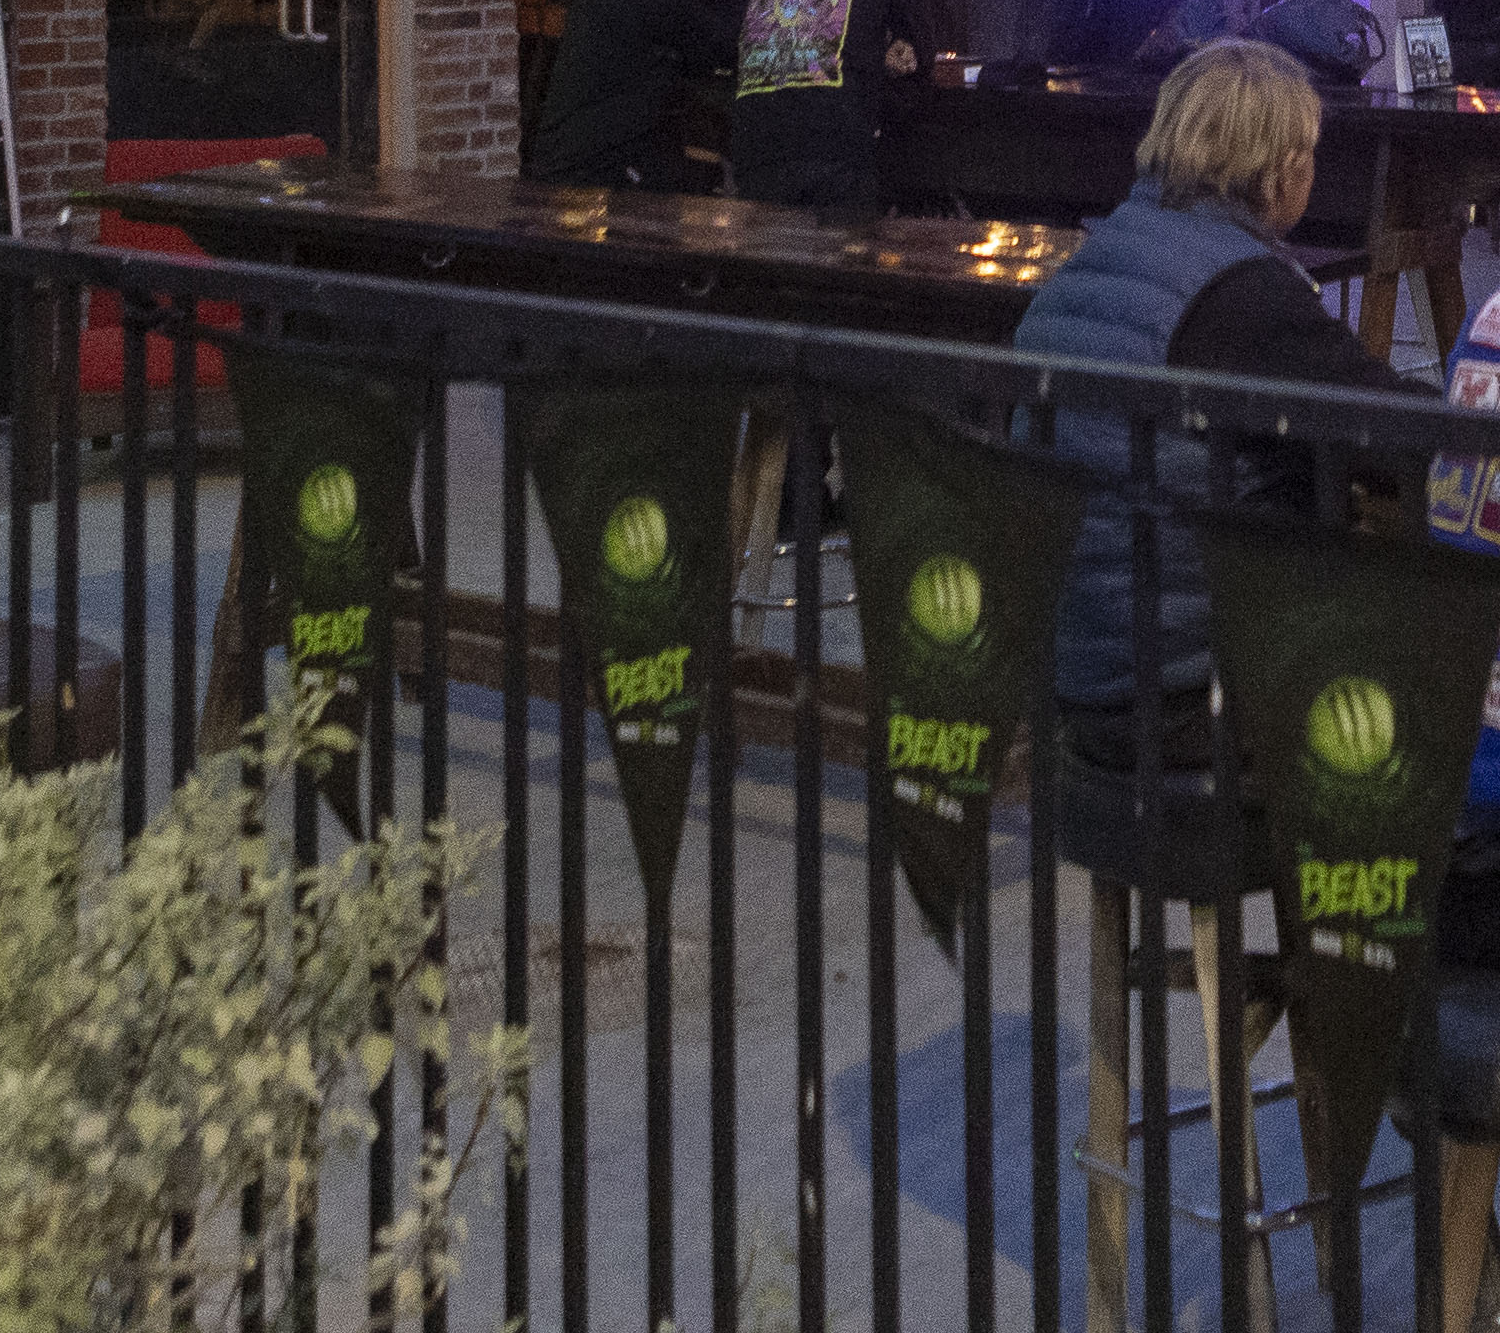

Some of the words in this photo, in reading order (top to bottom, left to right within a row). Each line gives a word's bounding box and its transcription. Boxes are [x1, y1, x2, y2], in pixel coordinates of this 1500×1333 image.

[292, 604, 372, 659] BEAST
[604, 645, 692, 717] BEAST
[1300, 855, 1419, 923] BEAST
